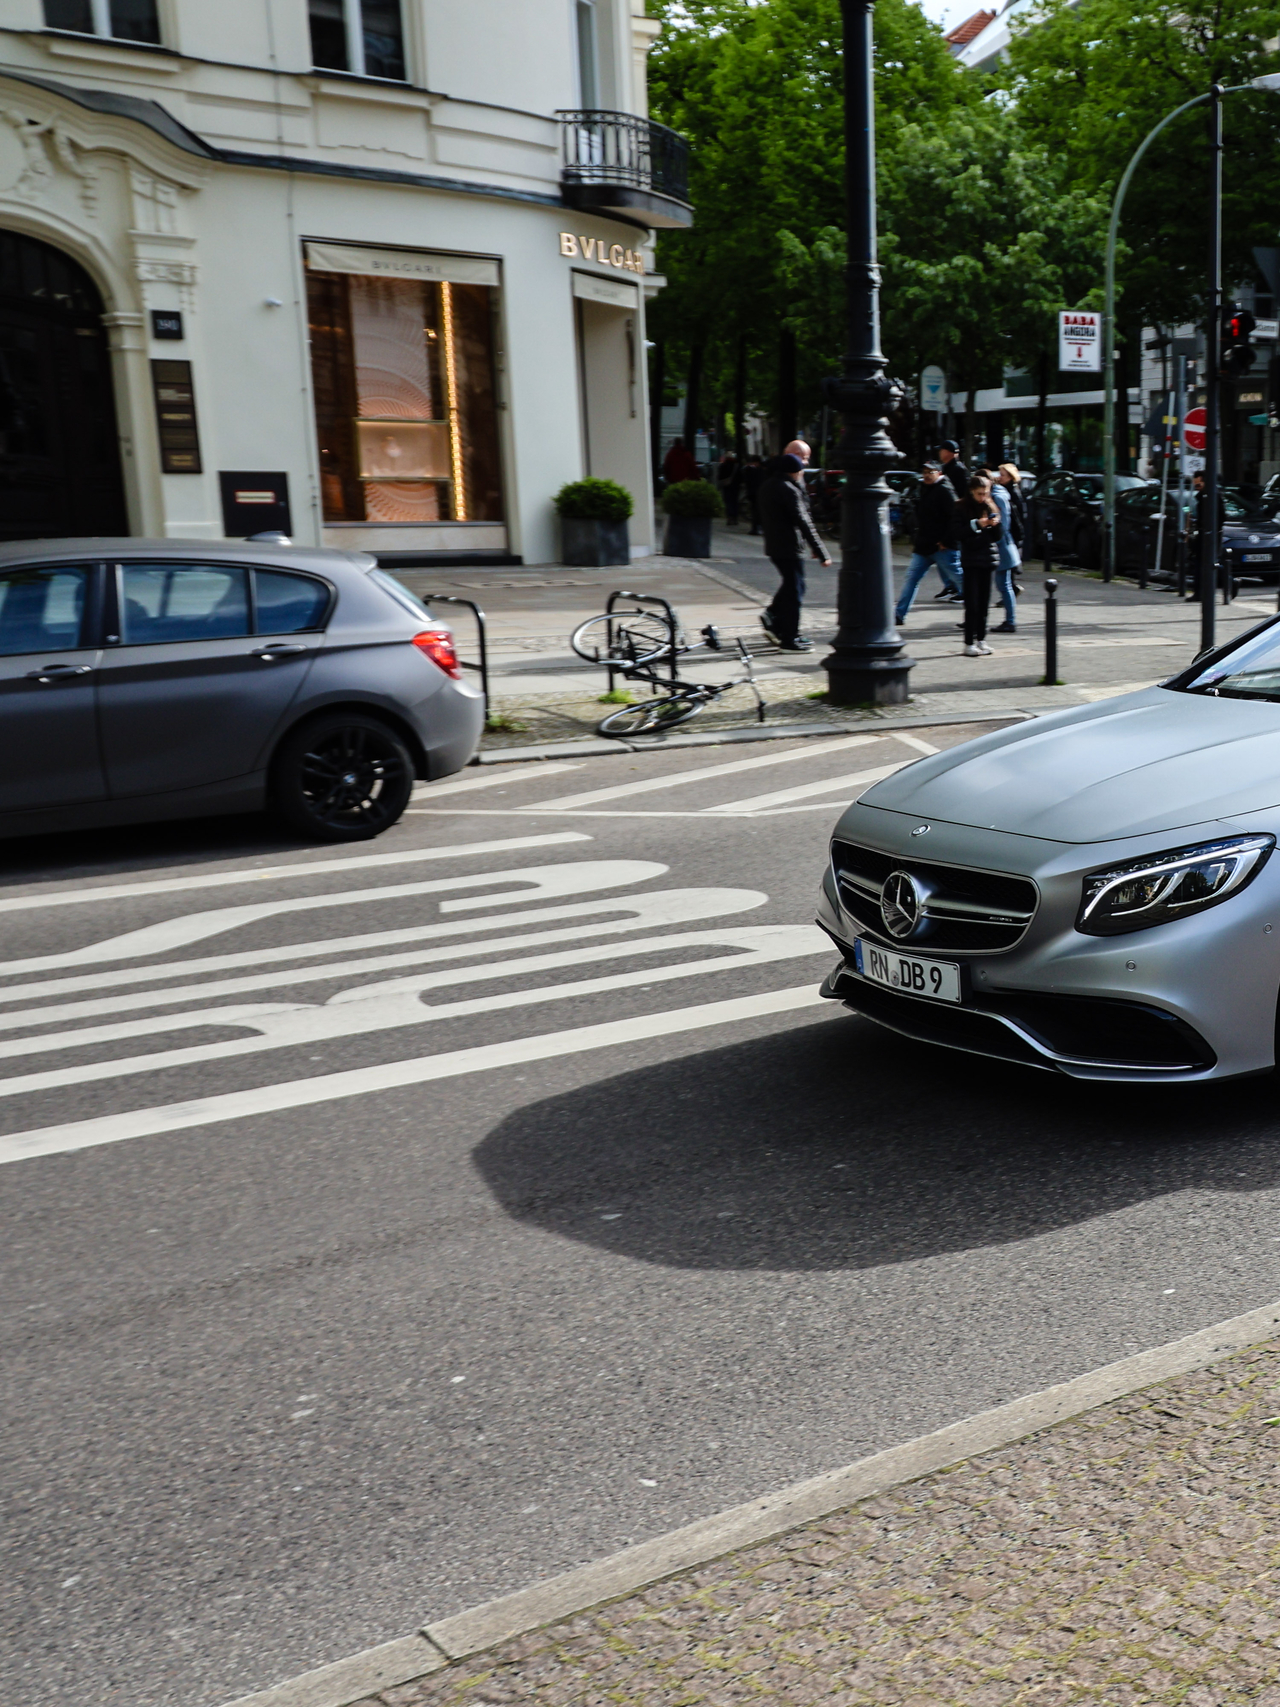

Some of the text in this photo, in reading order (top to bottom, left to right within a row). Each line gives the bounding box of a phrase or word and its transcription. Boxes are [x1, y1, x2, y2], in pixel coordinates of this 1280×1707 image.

[371, 260, 443, 274] BVLGARI
[1064, 315, 1096, 326] BABA
[869, 949, 943, 994] RN DB 9
